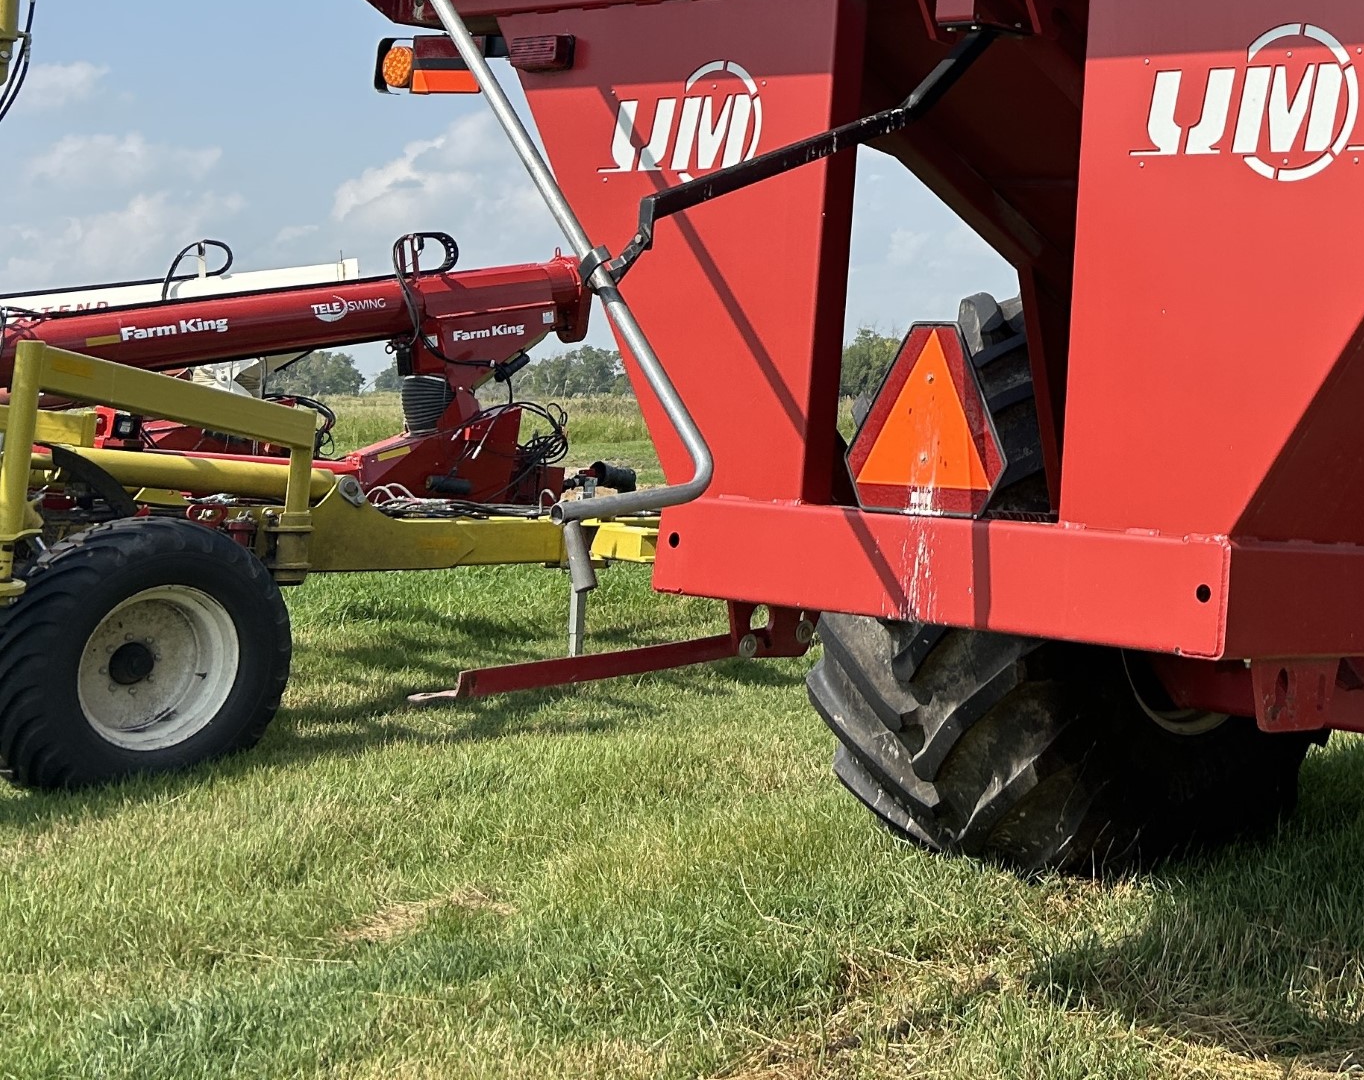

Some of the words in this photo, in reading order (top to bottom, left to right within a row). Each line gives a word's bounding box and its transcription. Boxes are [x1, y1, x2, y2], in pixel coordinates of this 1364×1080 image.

[311, 302, 341, 315] TELE
[348, 298, 387, 311] SWING
[121, 325, 178, 341] Farm
[179, 317, 229, 334] King
[452, 329, 490, 342] Farm
[492, 323, 525, 336] King
